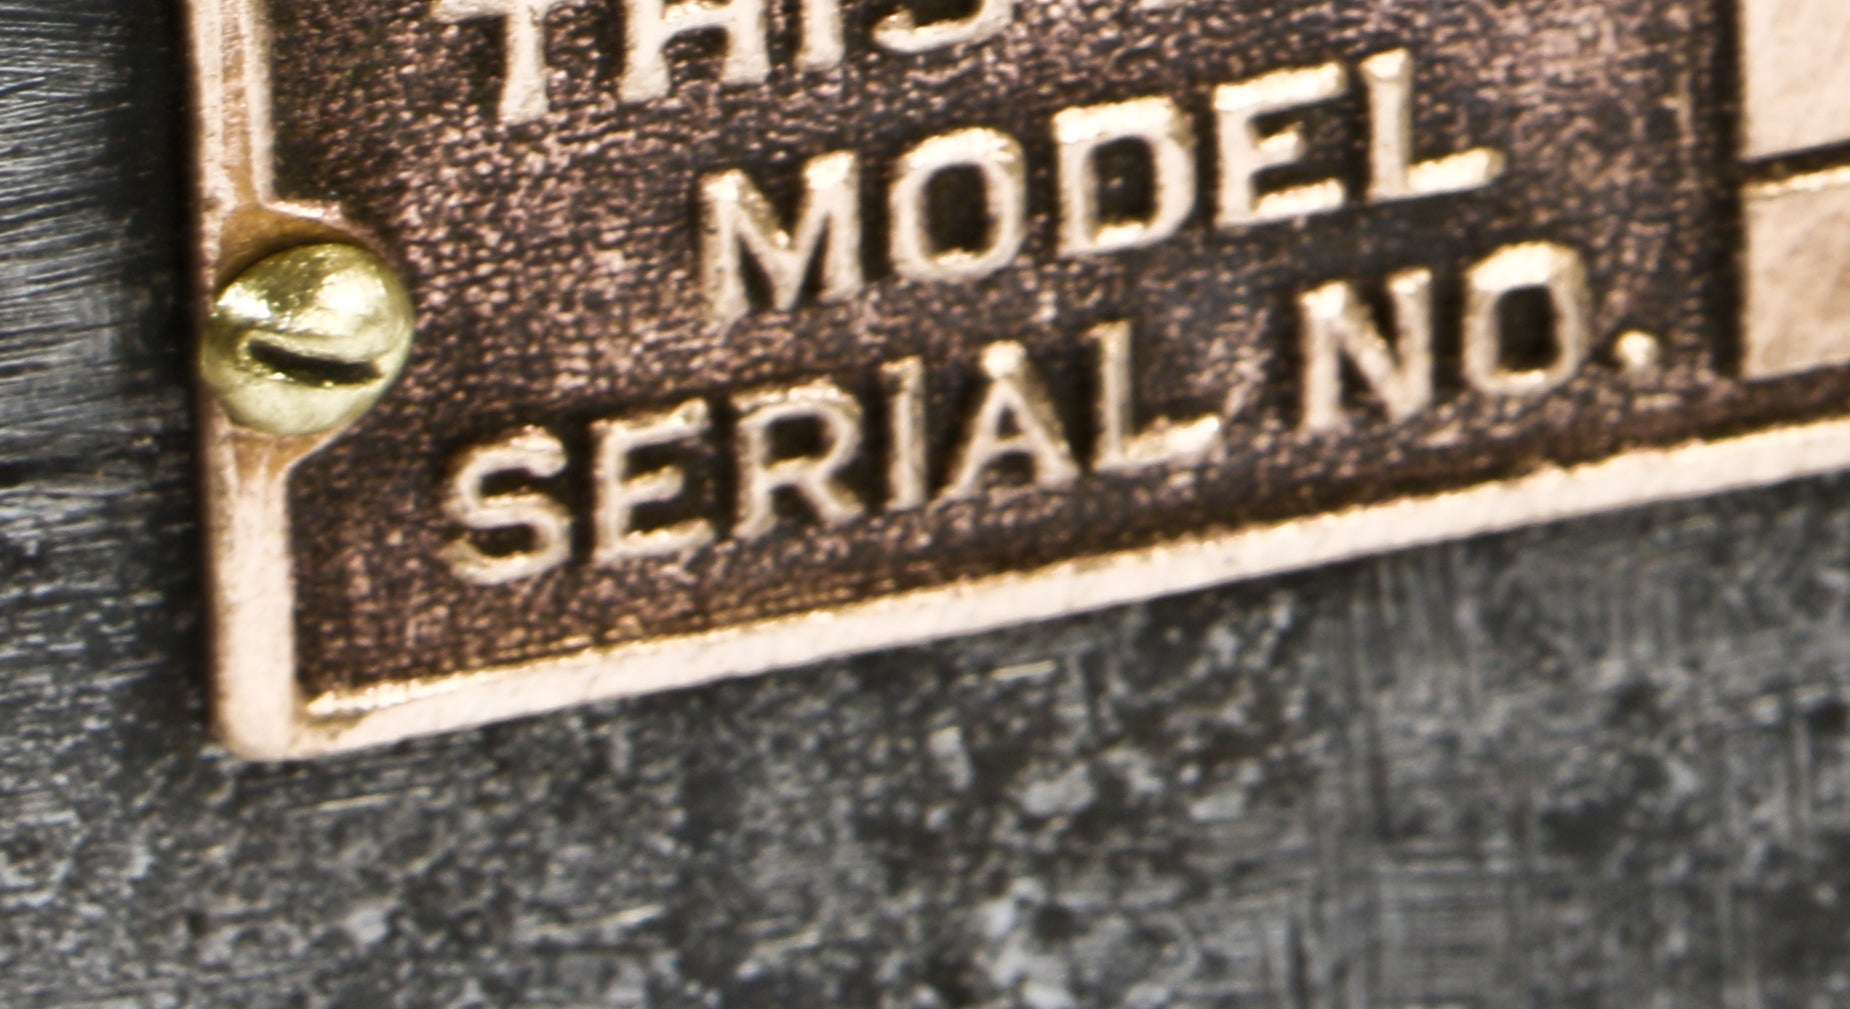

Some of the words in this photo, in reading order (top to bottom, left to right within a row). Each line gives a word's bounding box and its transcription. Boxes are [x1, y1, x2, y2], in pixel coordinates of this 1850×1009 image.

[700, 48, 1504, 324] MODEL
[441, 318, 1223, 586] SERIAL
[1300, 241, 1660, 436] NO.
